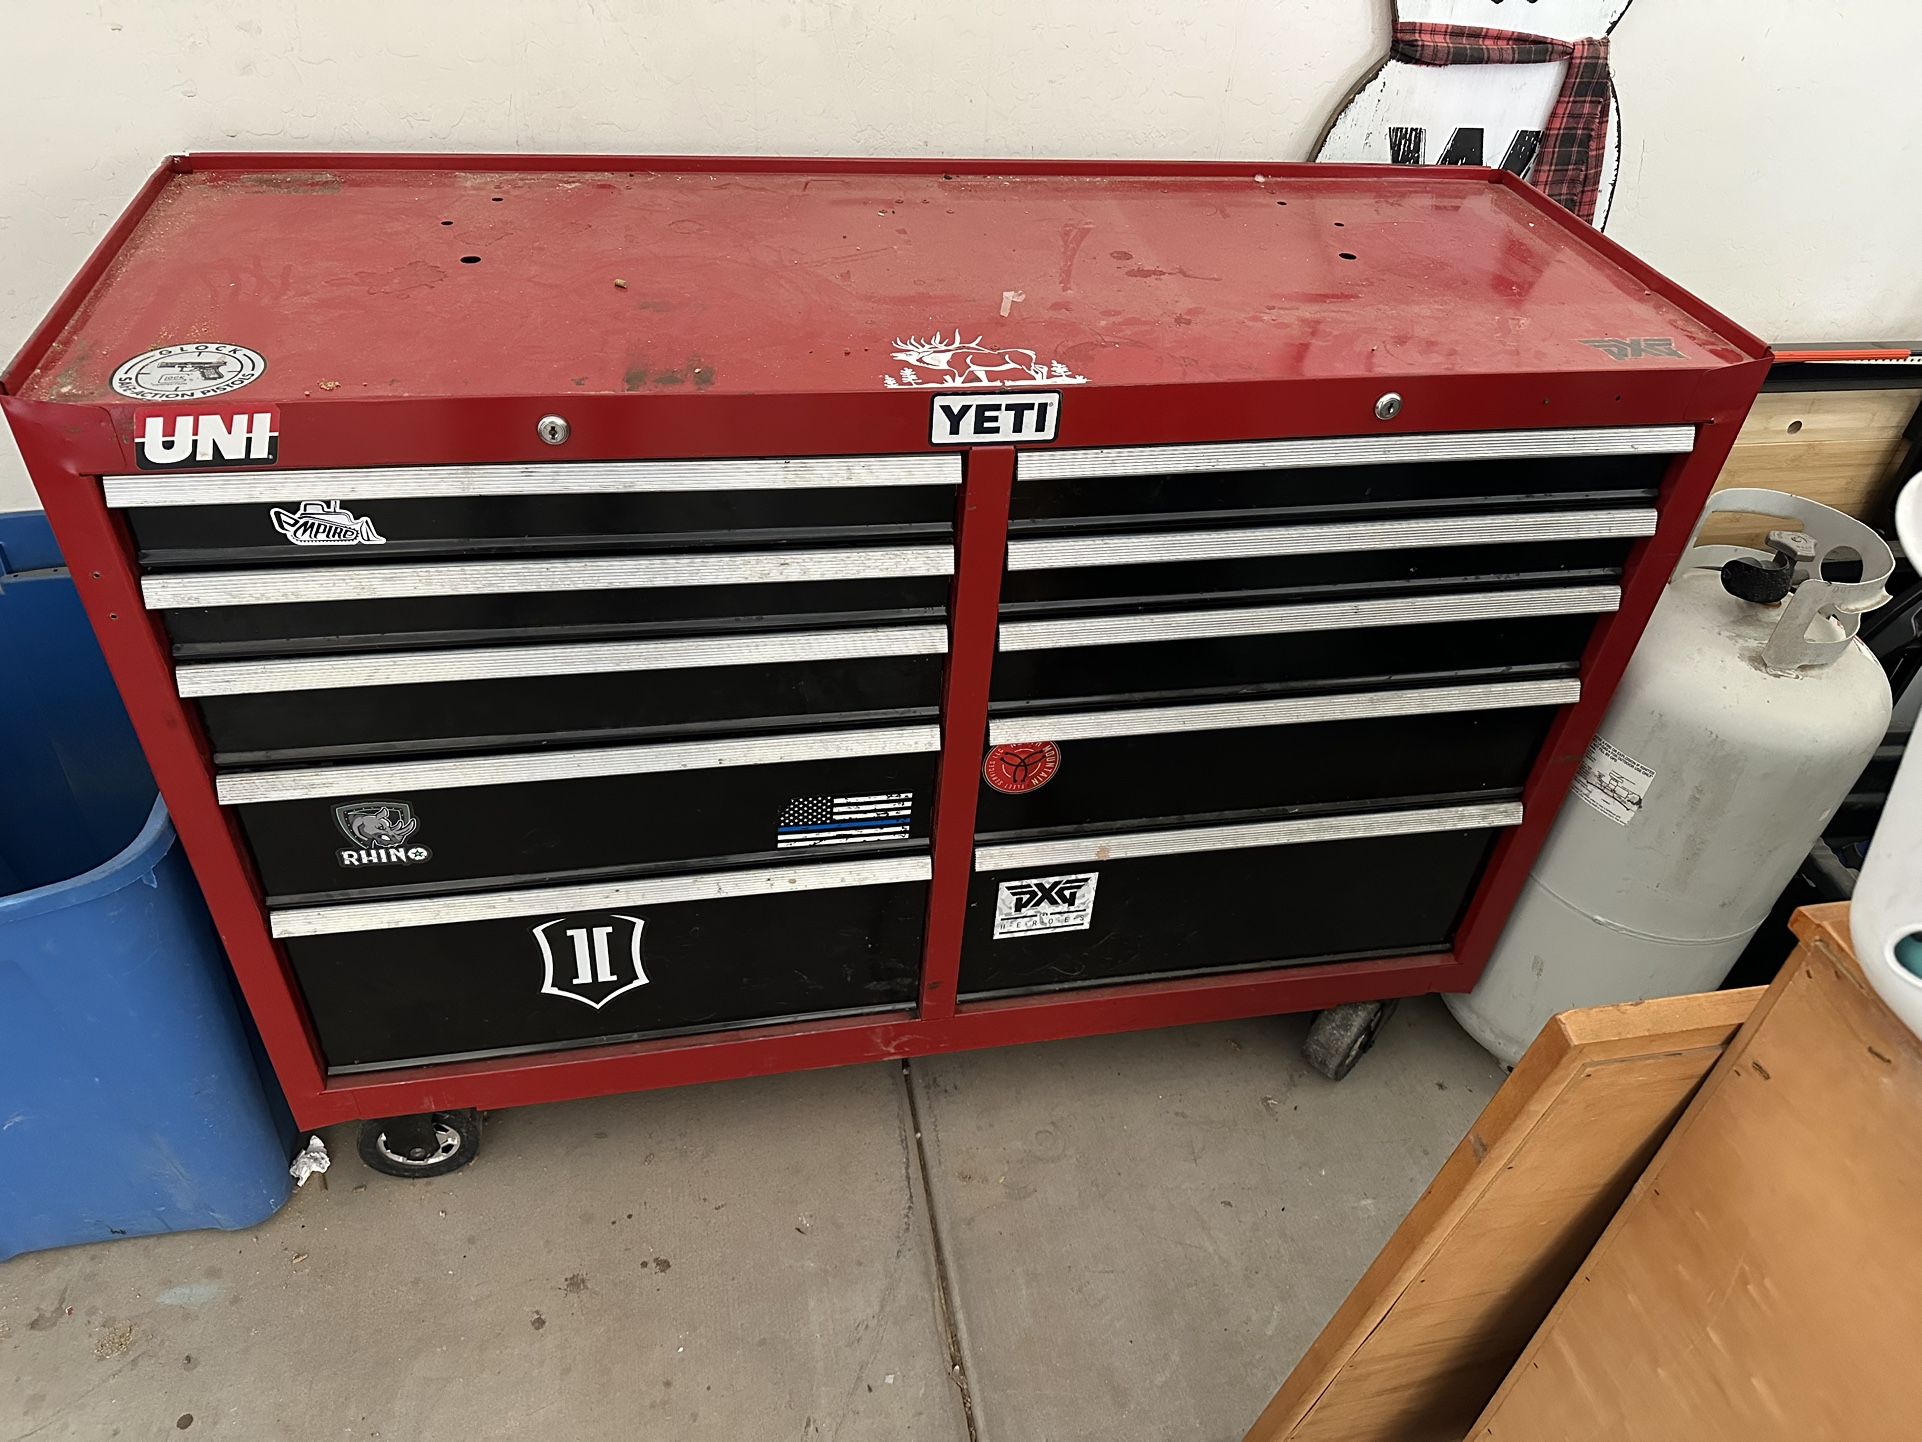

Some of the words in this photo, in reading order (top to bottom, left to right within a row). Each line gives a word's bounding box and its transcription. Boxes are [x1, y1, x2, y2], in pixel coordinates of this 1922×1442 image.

[159, 345, 245, 356] GLOCK
[200, 372, 255, 396] PISTOLS
[939, 402, 1049, 436] YETI
[143, 413, 272, 464] UNI
[992, 748, 1004, 759] LLC
[1030, 744, 1056, 786] MOUNTAIN
[1004, 877, 1092, 913] PXG
[1000, 914, 1085, 930] HEROES
